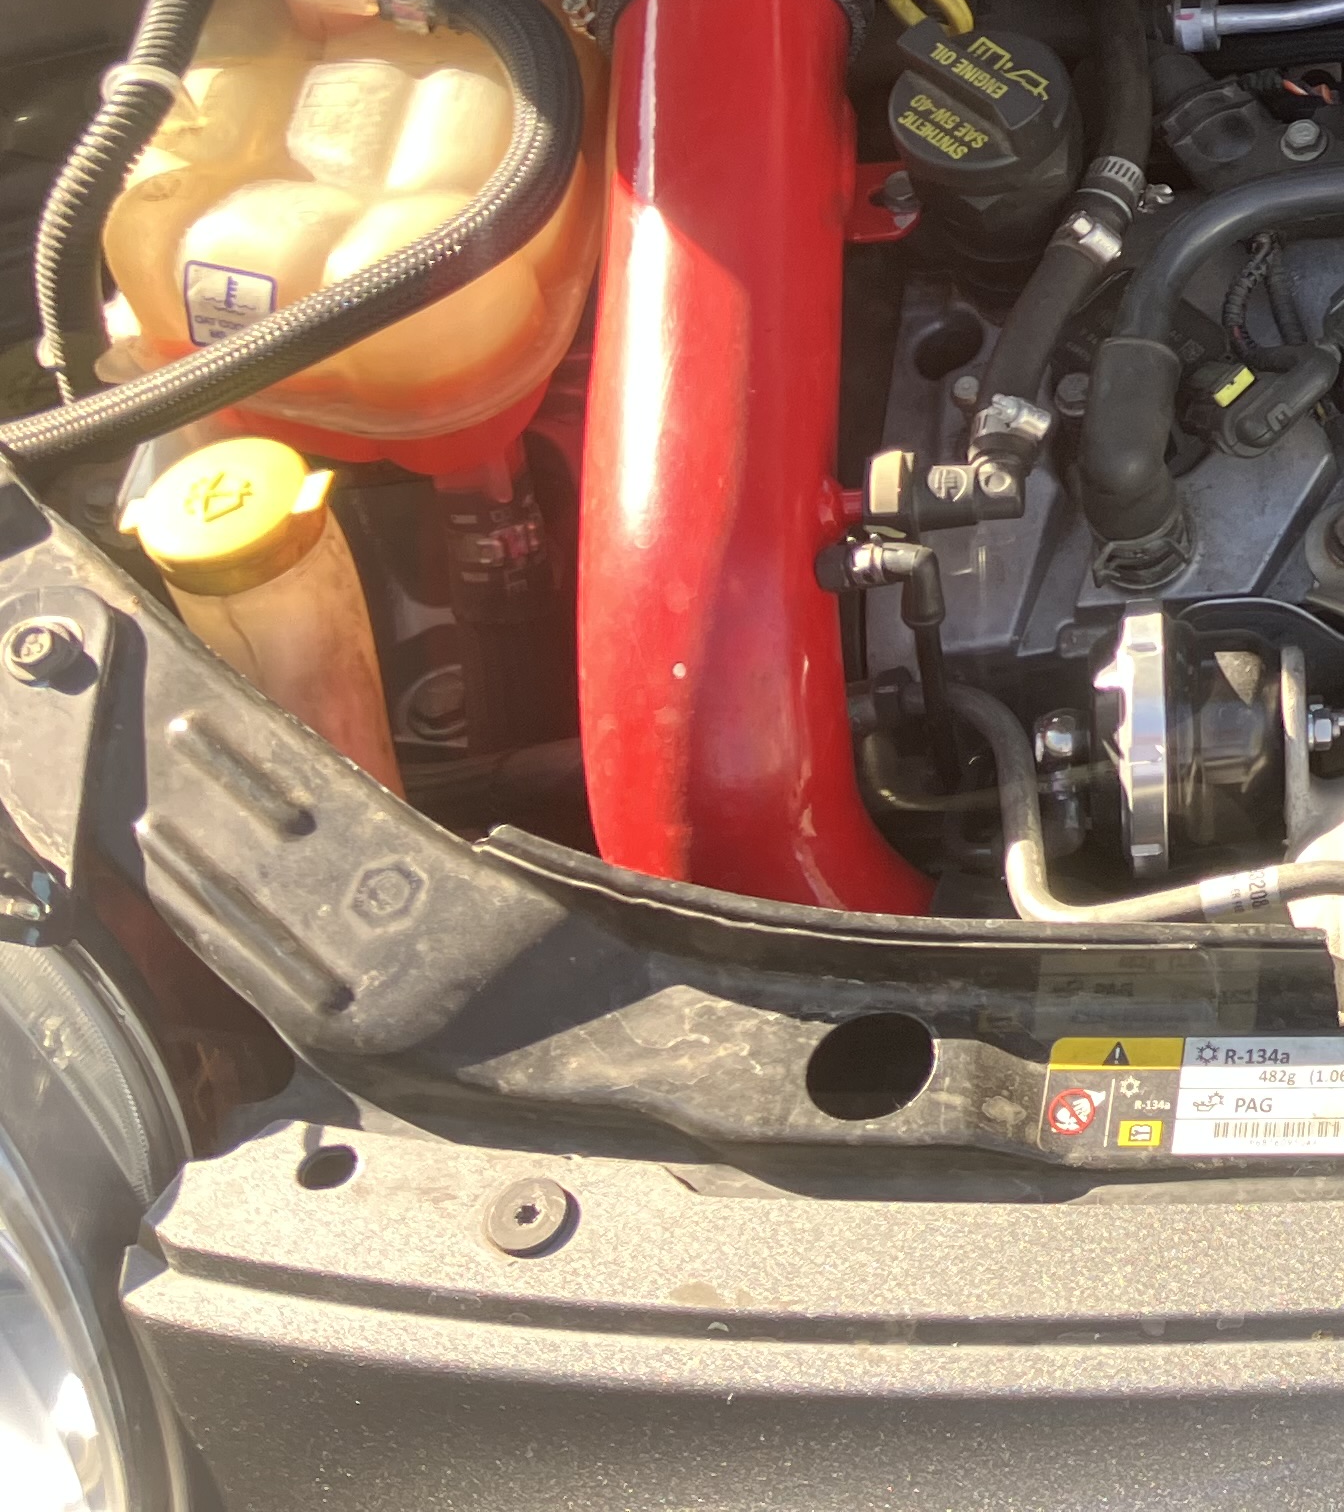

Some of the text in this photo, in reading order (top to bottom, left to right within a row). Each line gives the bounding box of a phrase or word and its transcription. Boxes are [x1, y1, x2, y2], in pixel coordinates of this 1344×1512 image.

[929, 42, 1008, 99] ENGINE OIL
[910, 94, 989, 149] SAE 5W-40
[898, 112, 969, 160] SYNTHETIC
[1224, 1048, 1291, 1065] R-134a
[1258, 1069, 1296, 1086] 482g
[1134, 1100, 1171, 1110] R-134a
[1234, 1097, 1273, 1114] PAG
